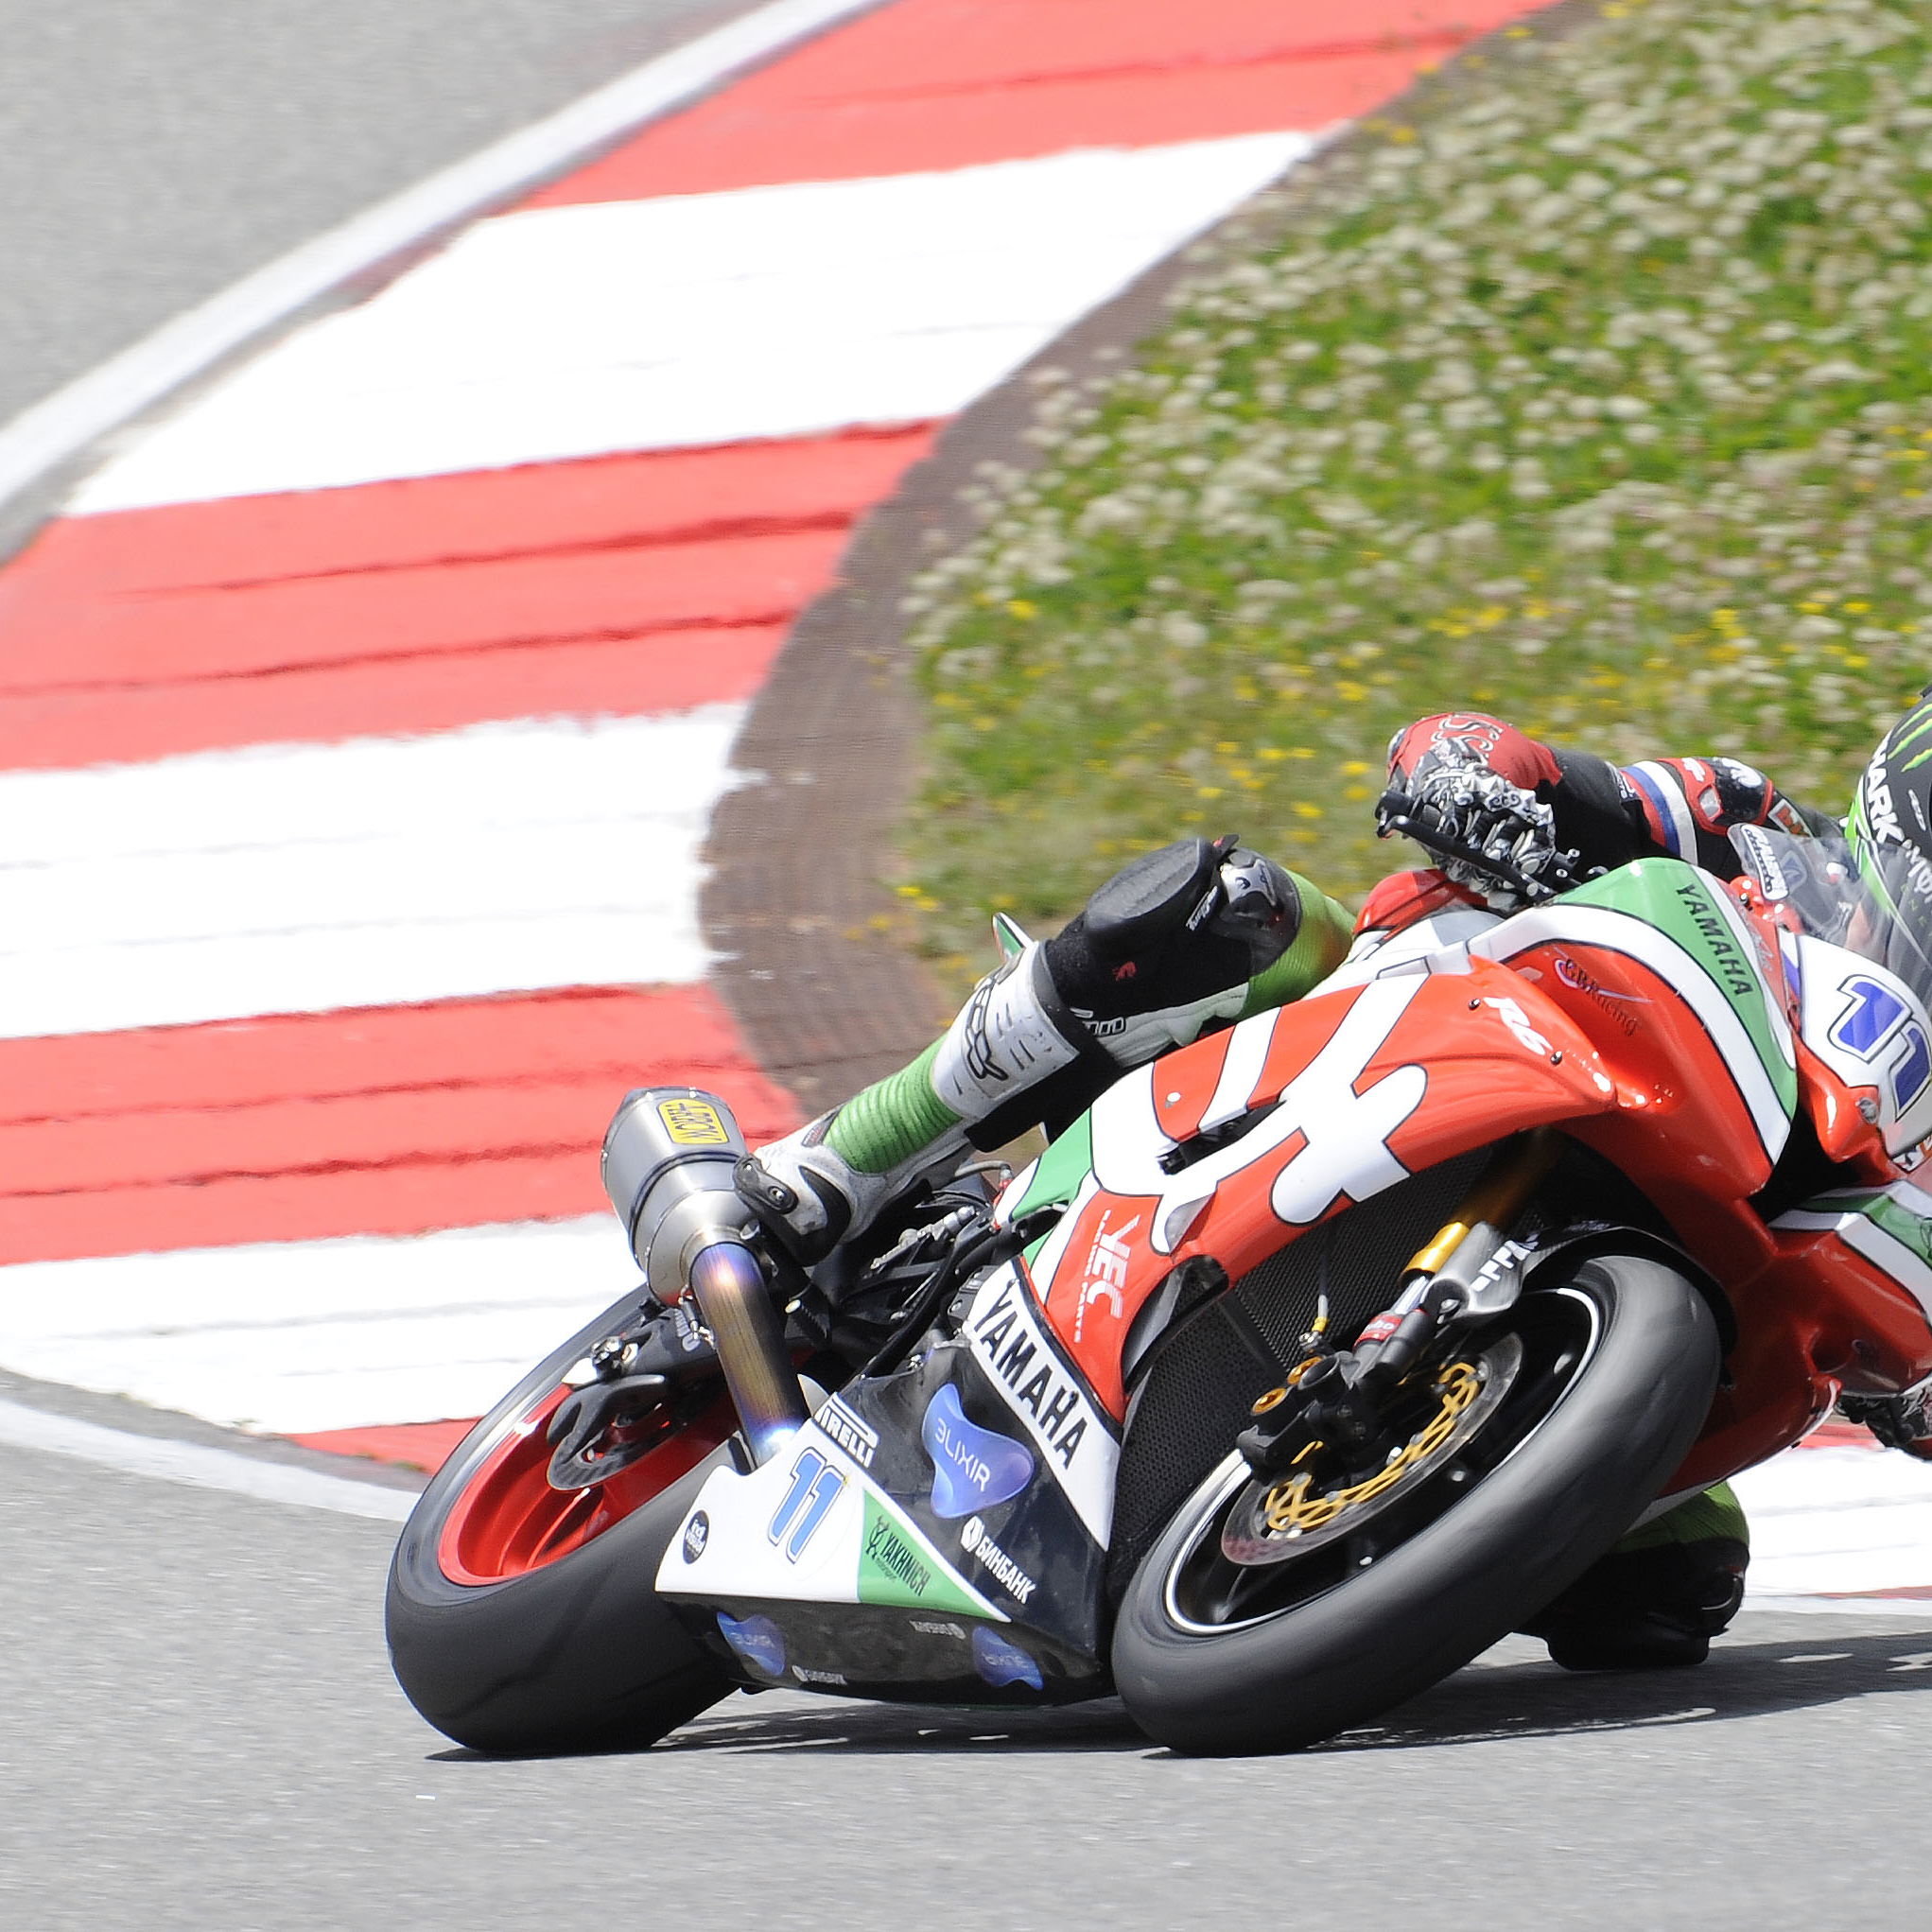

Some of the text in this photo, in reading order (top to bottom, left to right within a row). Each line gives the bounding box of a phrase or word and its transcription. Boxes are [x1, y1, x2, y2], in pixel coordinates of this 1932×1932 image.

[1675, 882, 1755, 997] YAMAHA
[1087, 1214, 1140, 1319] YEC
[972, 1279, 1088, 1471] YAMAHA
[813, 1393, 880, 1470] PIRELLI
[767, 1446, 850, 1566] 11
[879, 1531, 931, 1597] YAKHNICH
[975, 1529, 1036, 1606] БИНБАНК
